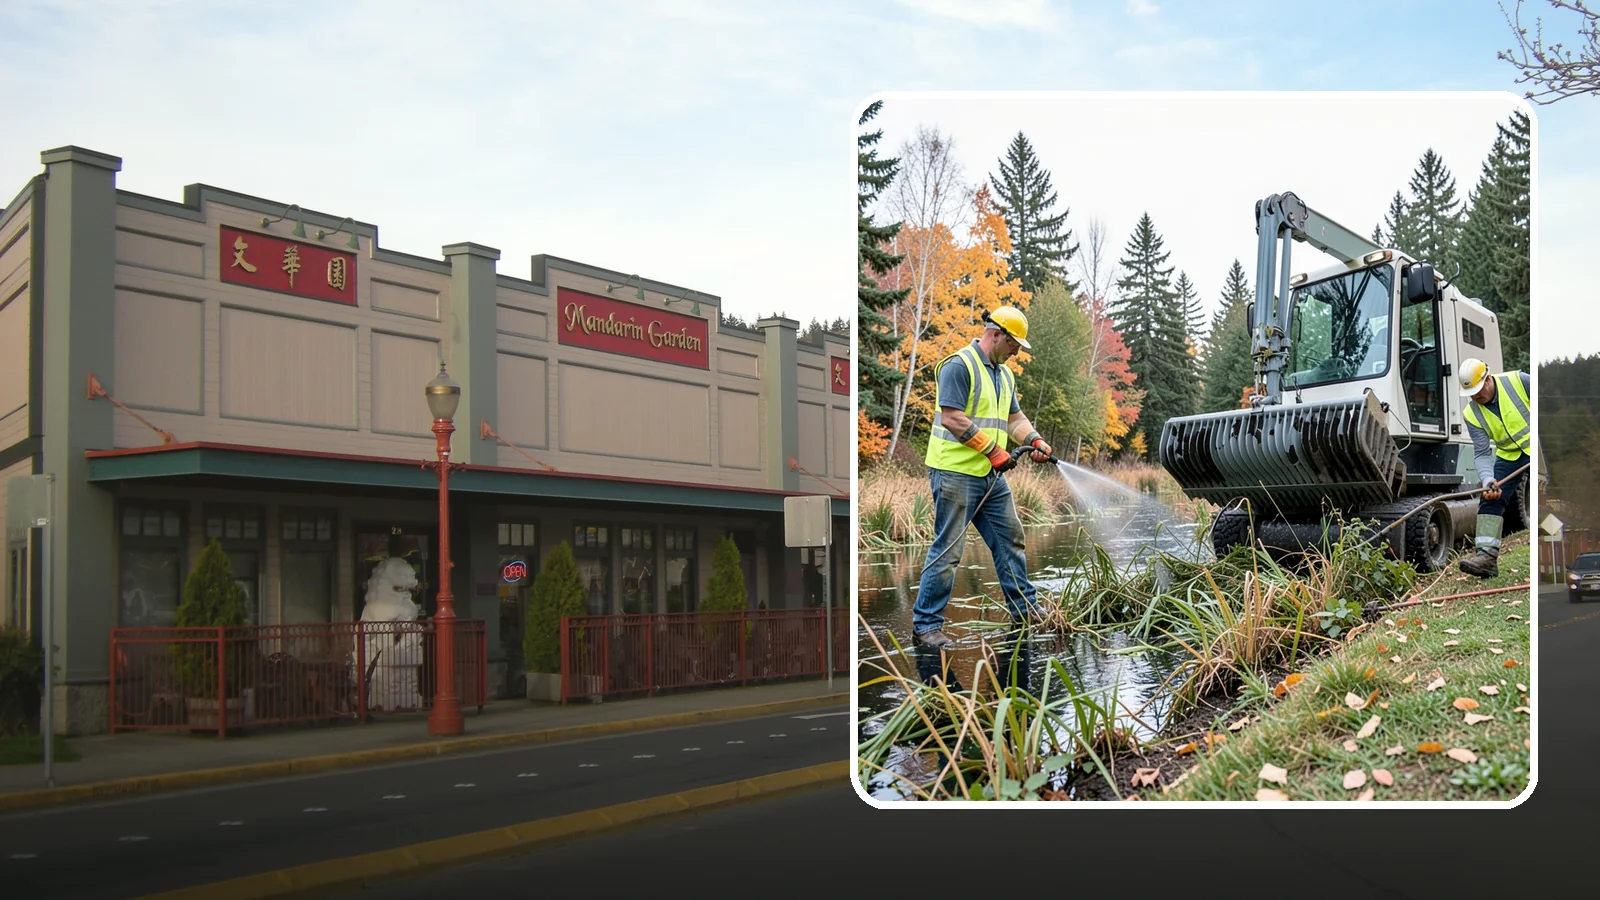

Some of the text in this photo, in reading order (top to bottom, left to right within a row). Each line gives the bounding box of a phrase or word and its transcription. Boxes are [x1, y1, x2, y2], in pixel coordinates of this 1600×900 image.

[230, 235, 347, 291] 文華園
[564, 302, 702, 352] Mandarin Garden
[503, 565, 527, 578] OPEN
